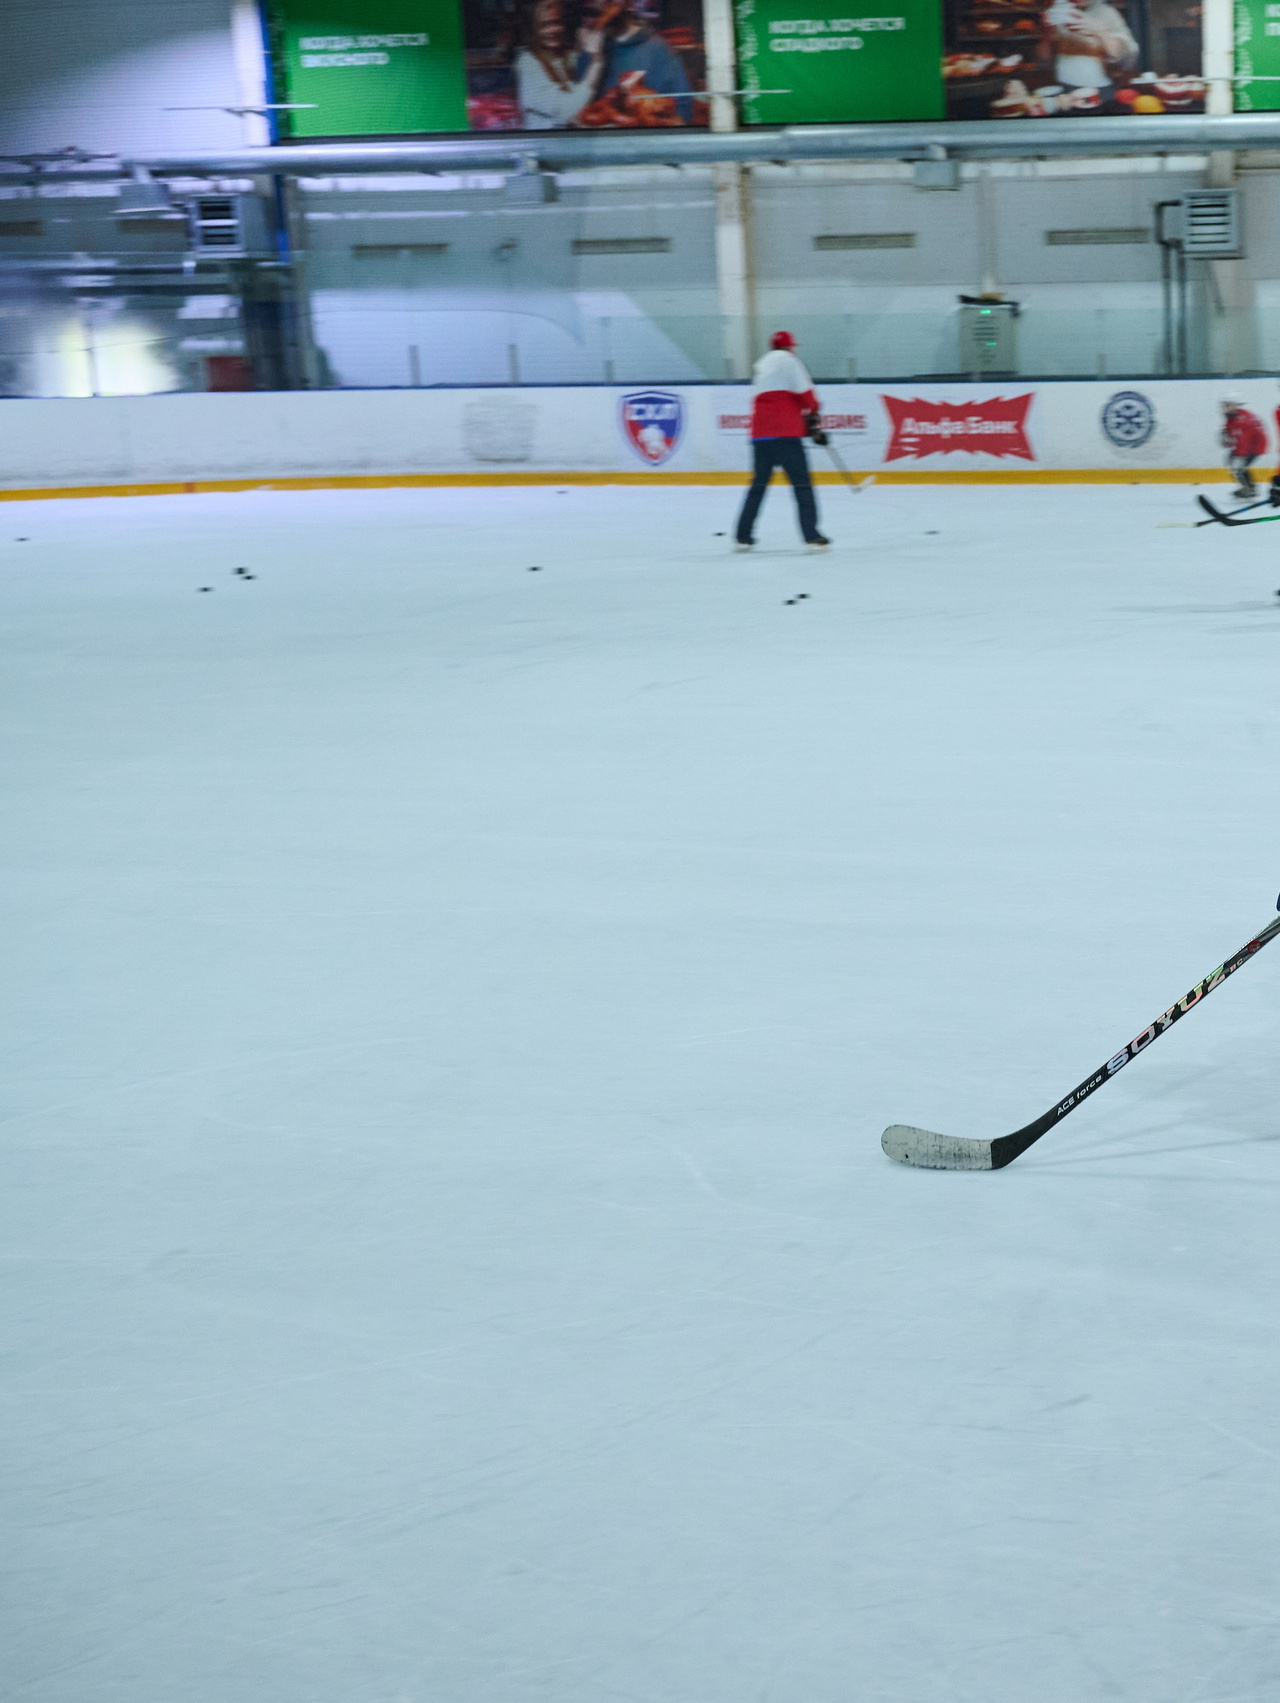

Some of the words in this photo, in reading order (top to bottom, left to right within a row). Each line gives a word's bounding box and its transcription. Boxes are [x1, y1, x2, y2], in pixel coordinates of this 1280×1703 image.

[900, 417, 964, 438] Альфа
[966, 416, 1020, 435] Банк
[1106, 963, 1226, 1075] SOYUZ
[1056, 1096, 1075, 1116] ACE
